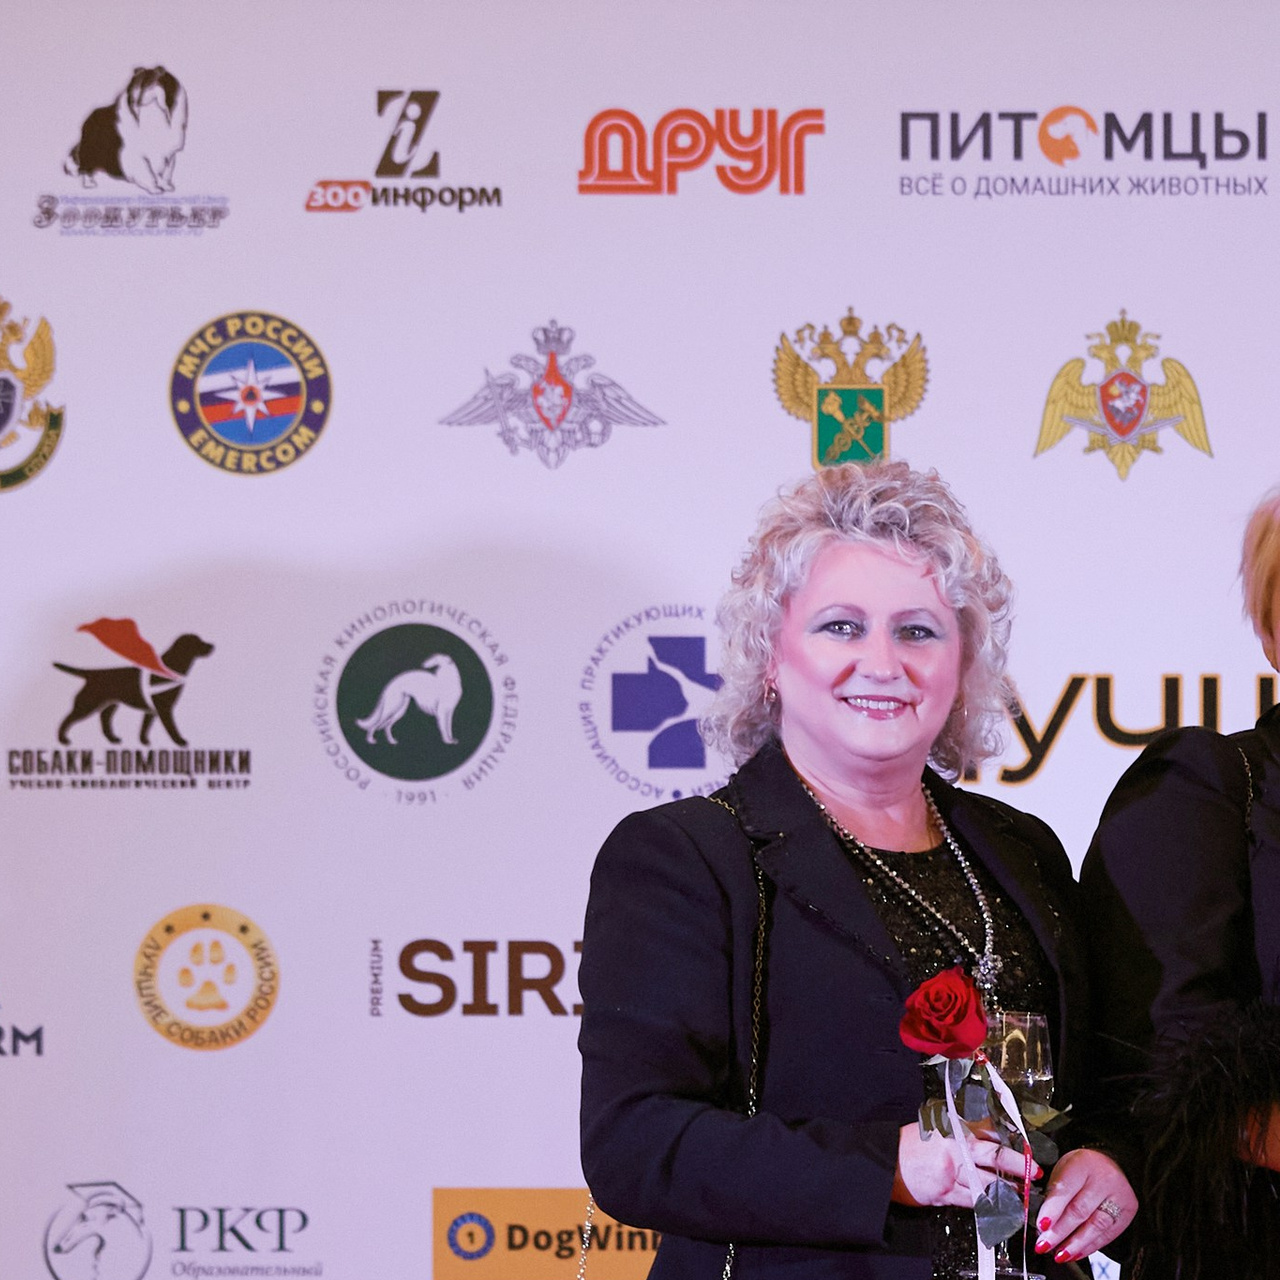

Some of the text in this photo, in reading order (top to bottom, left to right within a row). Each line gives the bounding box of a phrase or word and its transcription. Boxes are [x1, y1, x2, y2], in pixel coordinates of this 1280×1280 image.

[900, 173, 1269, 200] ВСЁ О ДОМАШНИХ ЖИВОТНЫХ
[177, 315, 325, 379] МЧС РОССИИ
[189, 425, 316, 472] EMERCOM
[313, 600, 519, 790] РОССИЙСКАЯ КИНОЛОГИЧЕСКАЯ ФЕДЕРАЦИЯ
[579, 604, 705, 799] АССОЦИАЦИЯ ПРАКТИКУЮЩИХ
[8, 750, 251, 778] СОБАКИ-ПОМОЩНИКИ
[396, 789, 437, 805] 1991
[136, 937, 275, 1047] ЛУЧШИЕ СОБАКИ РОССИИ
[370, 938, 383, 1017] PREMIUM
[171, 1207, 310, 1252] РКФ
